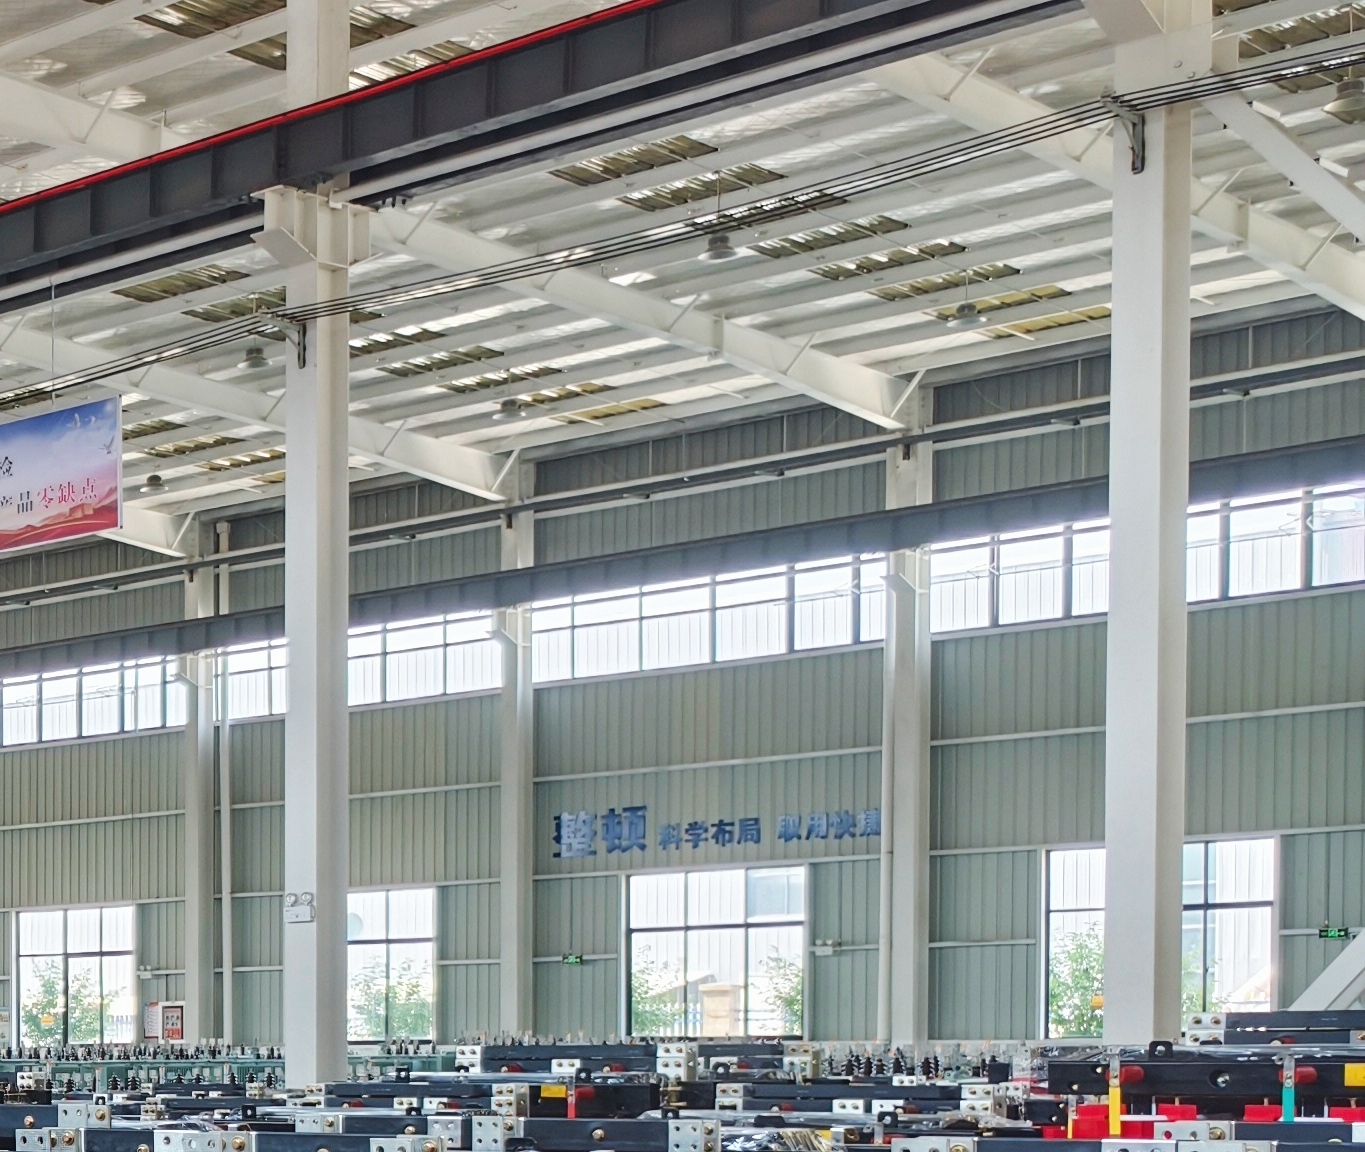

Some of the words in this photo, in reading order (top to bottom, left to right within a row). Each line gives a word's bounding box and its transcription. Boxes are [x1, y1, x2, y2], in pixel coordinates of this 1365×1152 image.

[552, 805, 648, 859] 整顿
[658, 817, 761, 851] 科学布局
[777, 807, 882, 843] 取用快捷
